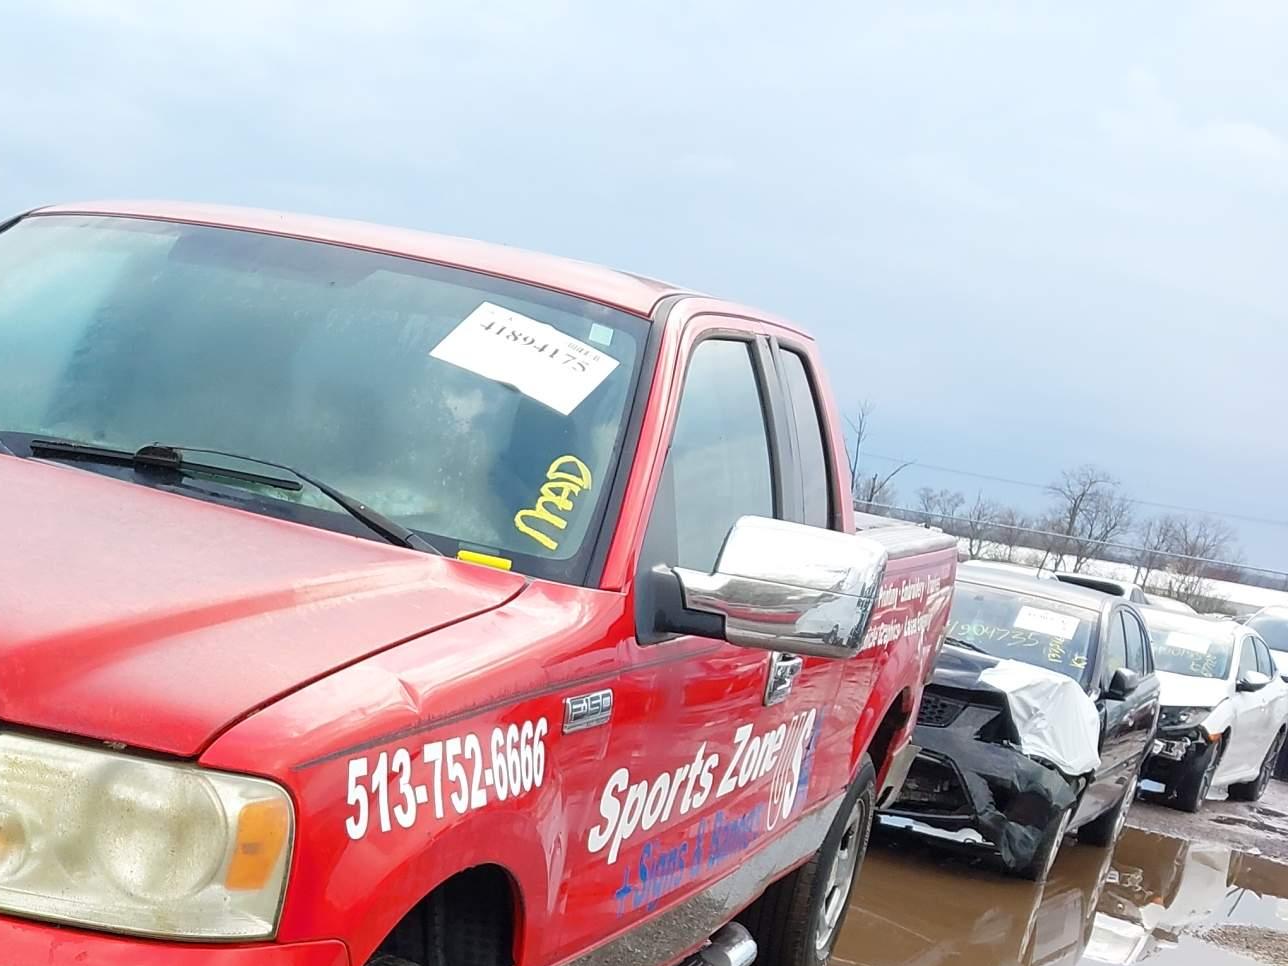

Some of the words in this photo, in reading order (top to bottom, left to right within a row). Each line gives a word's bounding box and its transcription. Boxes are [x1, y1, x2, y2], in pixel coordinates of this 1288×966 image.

[479, 321, 588, 373] 41894175
[514, 455, 592, 551] MAD
[345, 717, 548, 841] 513-752-6666
[587, 741, 719, 865] Sports
[715, 723, 787, 799] Zone
